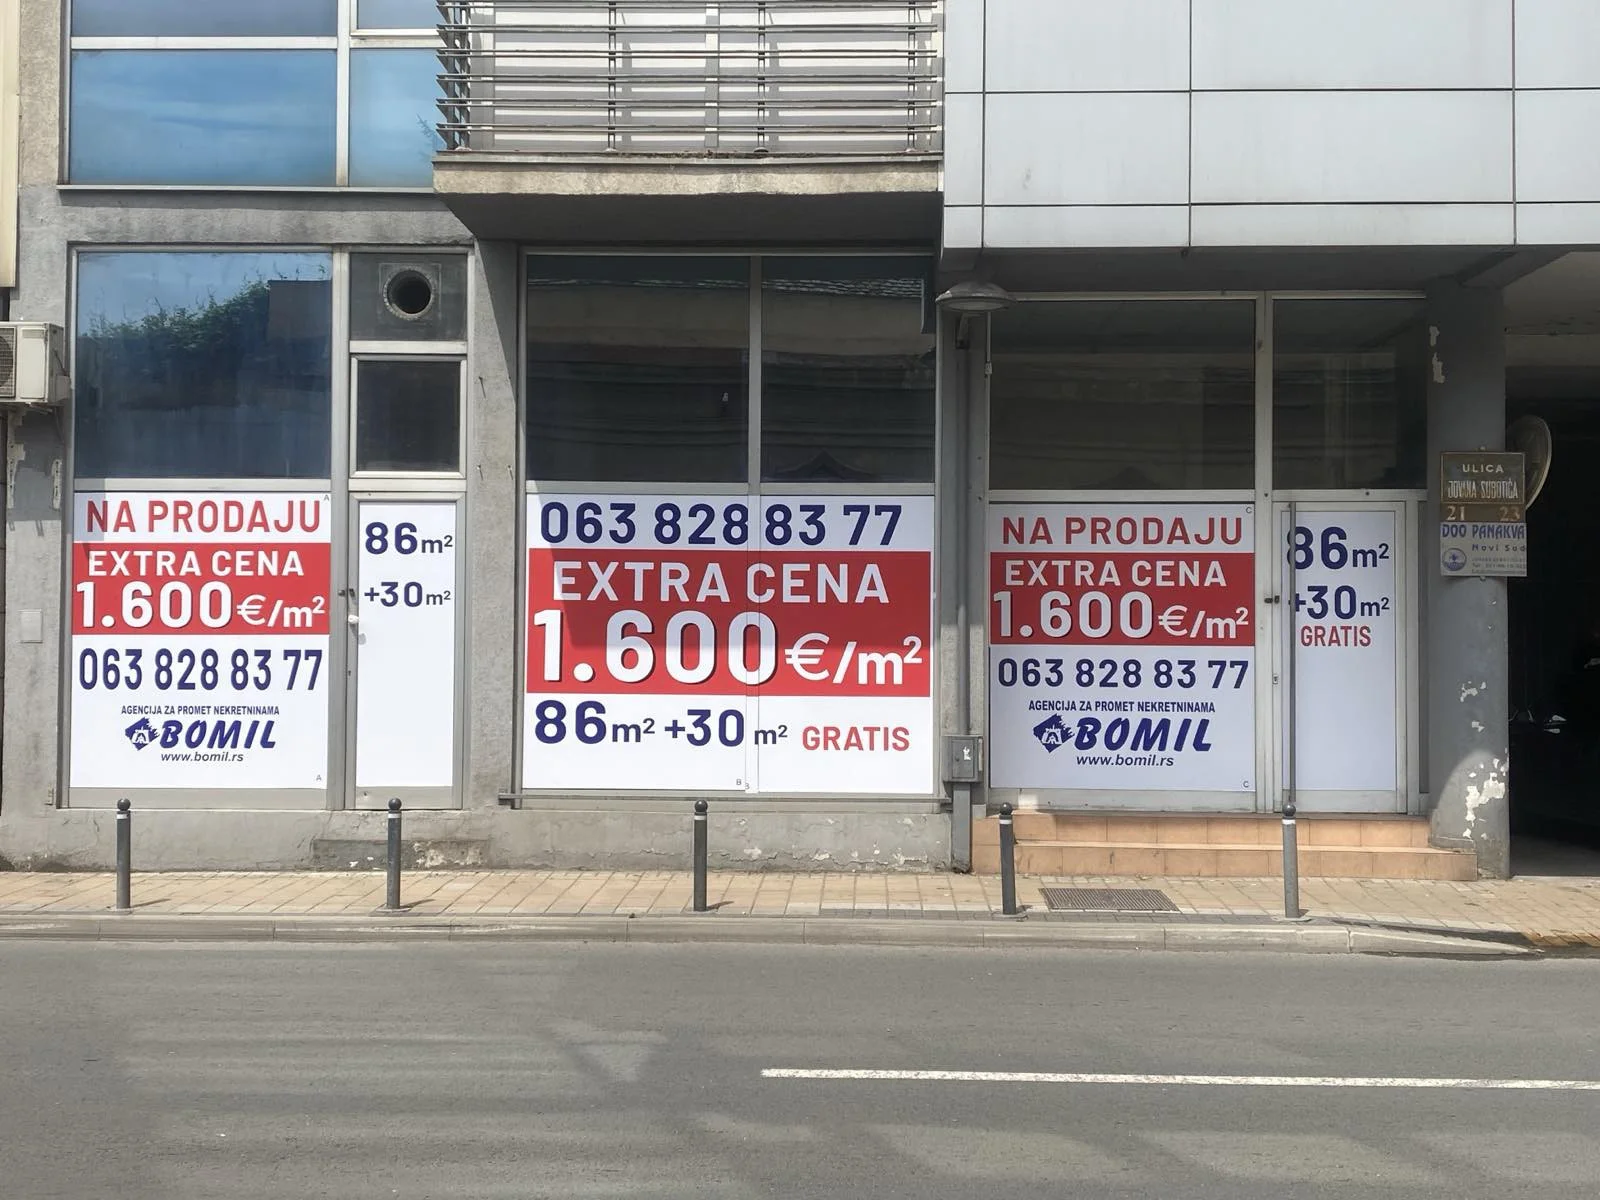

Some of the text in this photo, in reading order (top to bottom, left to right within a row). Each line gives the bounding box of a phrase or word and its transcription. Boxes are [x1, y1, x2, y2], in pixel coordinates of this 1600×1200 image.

[1462, 463, 1504, 473] ULICA
[86, 499, 322, 533] NA PRODAJU
[540, 501, 902, 547] 063 828 83 77
[1446, 505, 1521, 522] 21 23
[1002, 516, 1242, 546] NA PRODAJU
[1442, 524, 1525, 540] DOO PANAKVA
[88, 550, 304, 577] EXTRA CENA
[1004, 559, 1227, 587] EXTRA CENA
[552, 560, 890, 604] EXTRA CENA
[1300, 625, 1372, 647] GRATIS
[79, 647, 323, 691] 063 828 83 77
[998, 658, 1249, 689] 063 828 83 77
[121, 705, 280, 715] AGENCIJA ZA PROMET NEKRETNINAMA
[1028, 700, 1216, 713] AGENCIJA ZA PROMET NEKRETNINAMA
[159, 719, 276, 750] BOMIL
[802, 726, 910, 752] GRATIS
[1074, 716, 1213, 752] BOMIL
[161, 751, 244, 762] www.bomil.rs
[1076, 754, 1175, 767] www.bomil.rs
